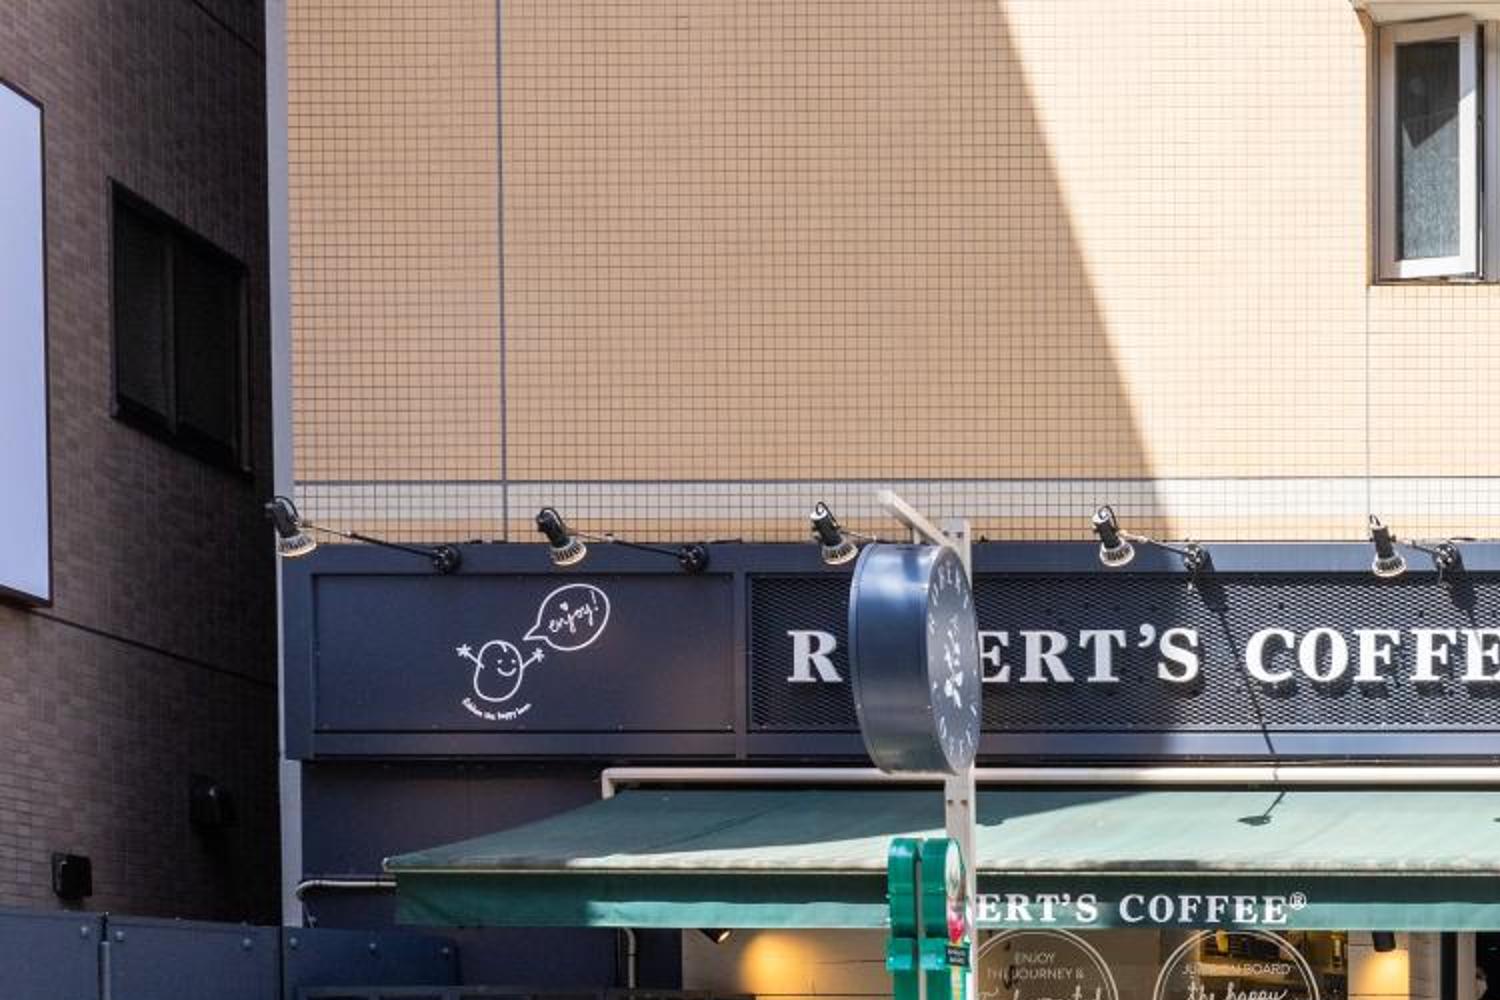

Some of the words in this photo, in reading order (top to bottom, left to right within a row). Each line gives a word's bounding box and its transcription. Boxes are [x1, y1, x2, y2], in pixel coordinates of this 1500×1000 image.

[548, 589, 599, 633] enjoy!
[786, 623, 1200, 684] RERT'S
[975, 893, 1098, 923] ERT'S
